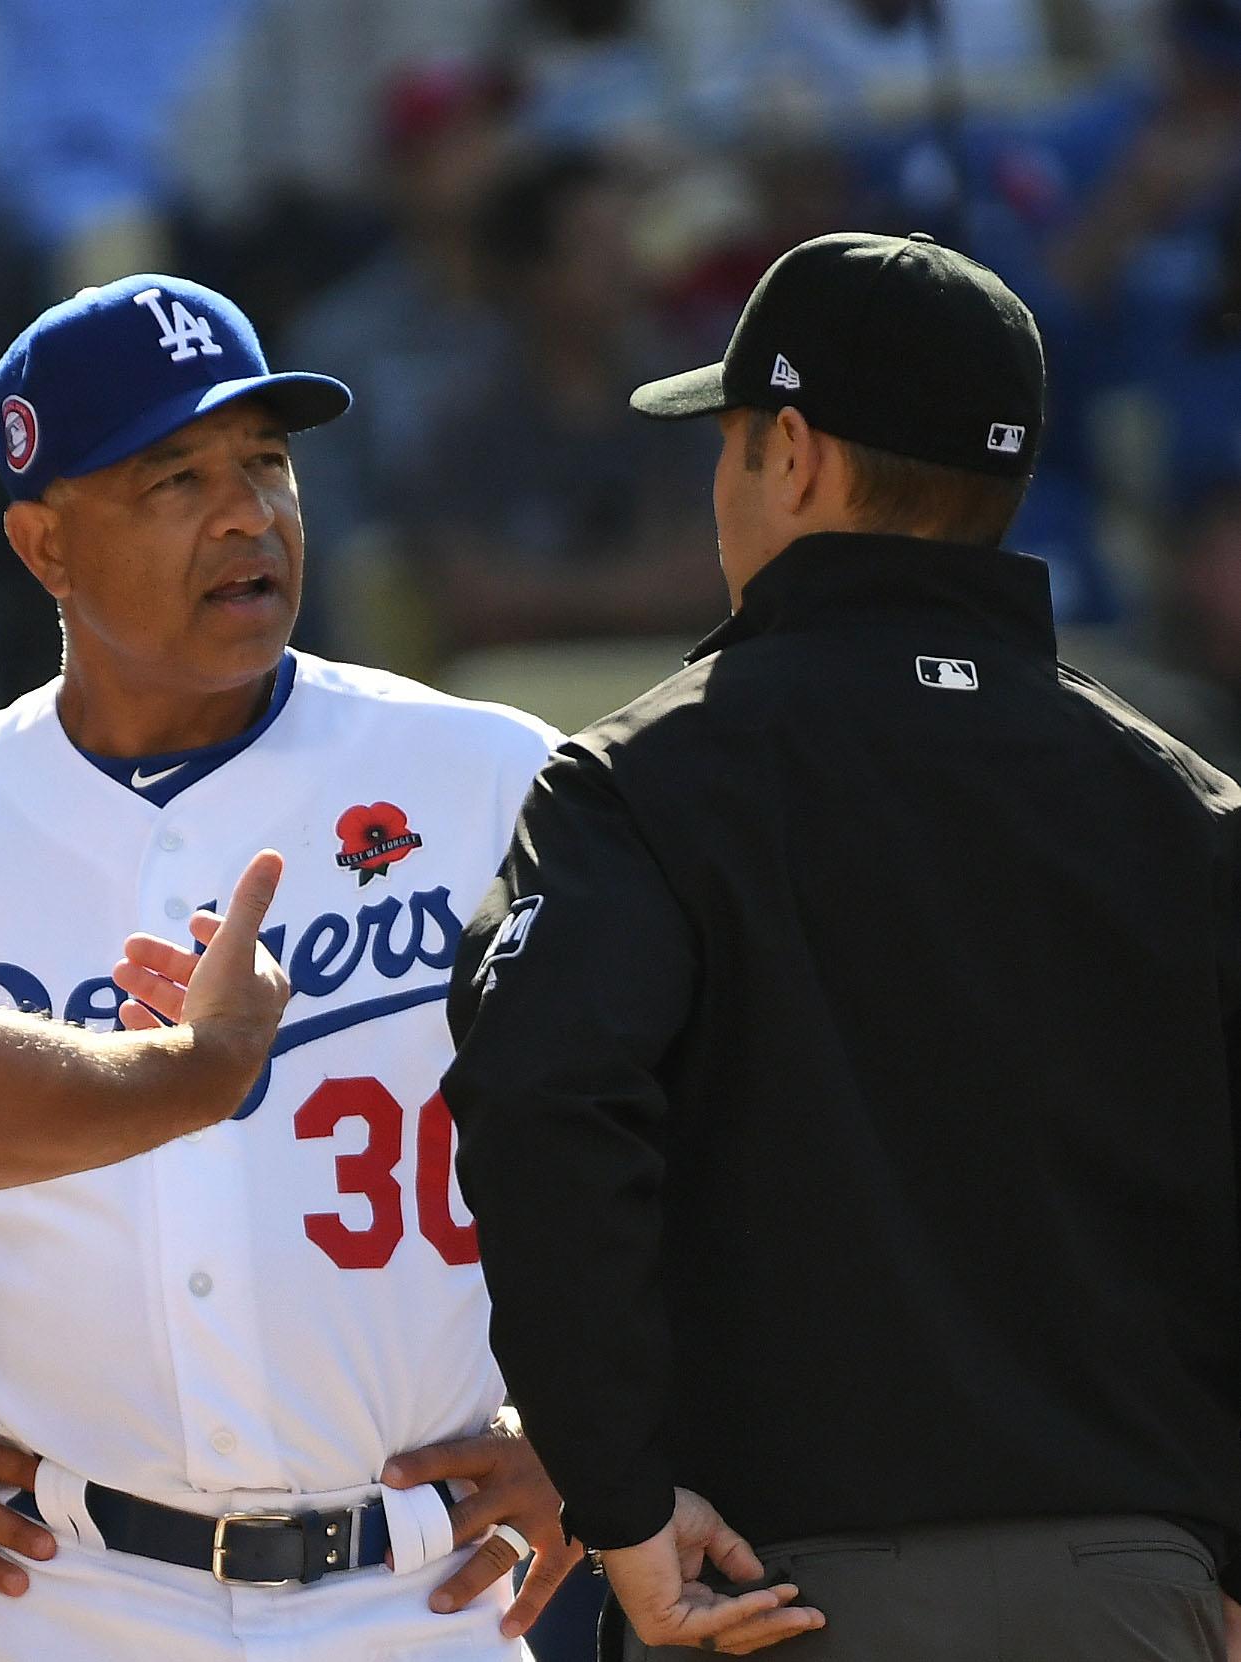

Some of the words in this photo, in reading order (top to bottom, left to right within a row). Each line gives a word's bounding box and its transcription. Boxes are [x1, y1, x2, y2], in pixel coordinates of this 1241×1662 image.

[133, 288, 223, 361] LA
[340, 852, 364, 865] LEST
[365, 846, 380, 857] WE
[381, 835, 417, 851] FORGET
